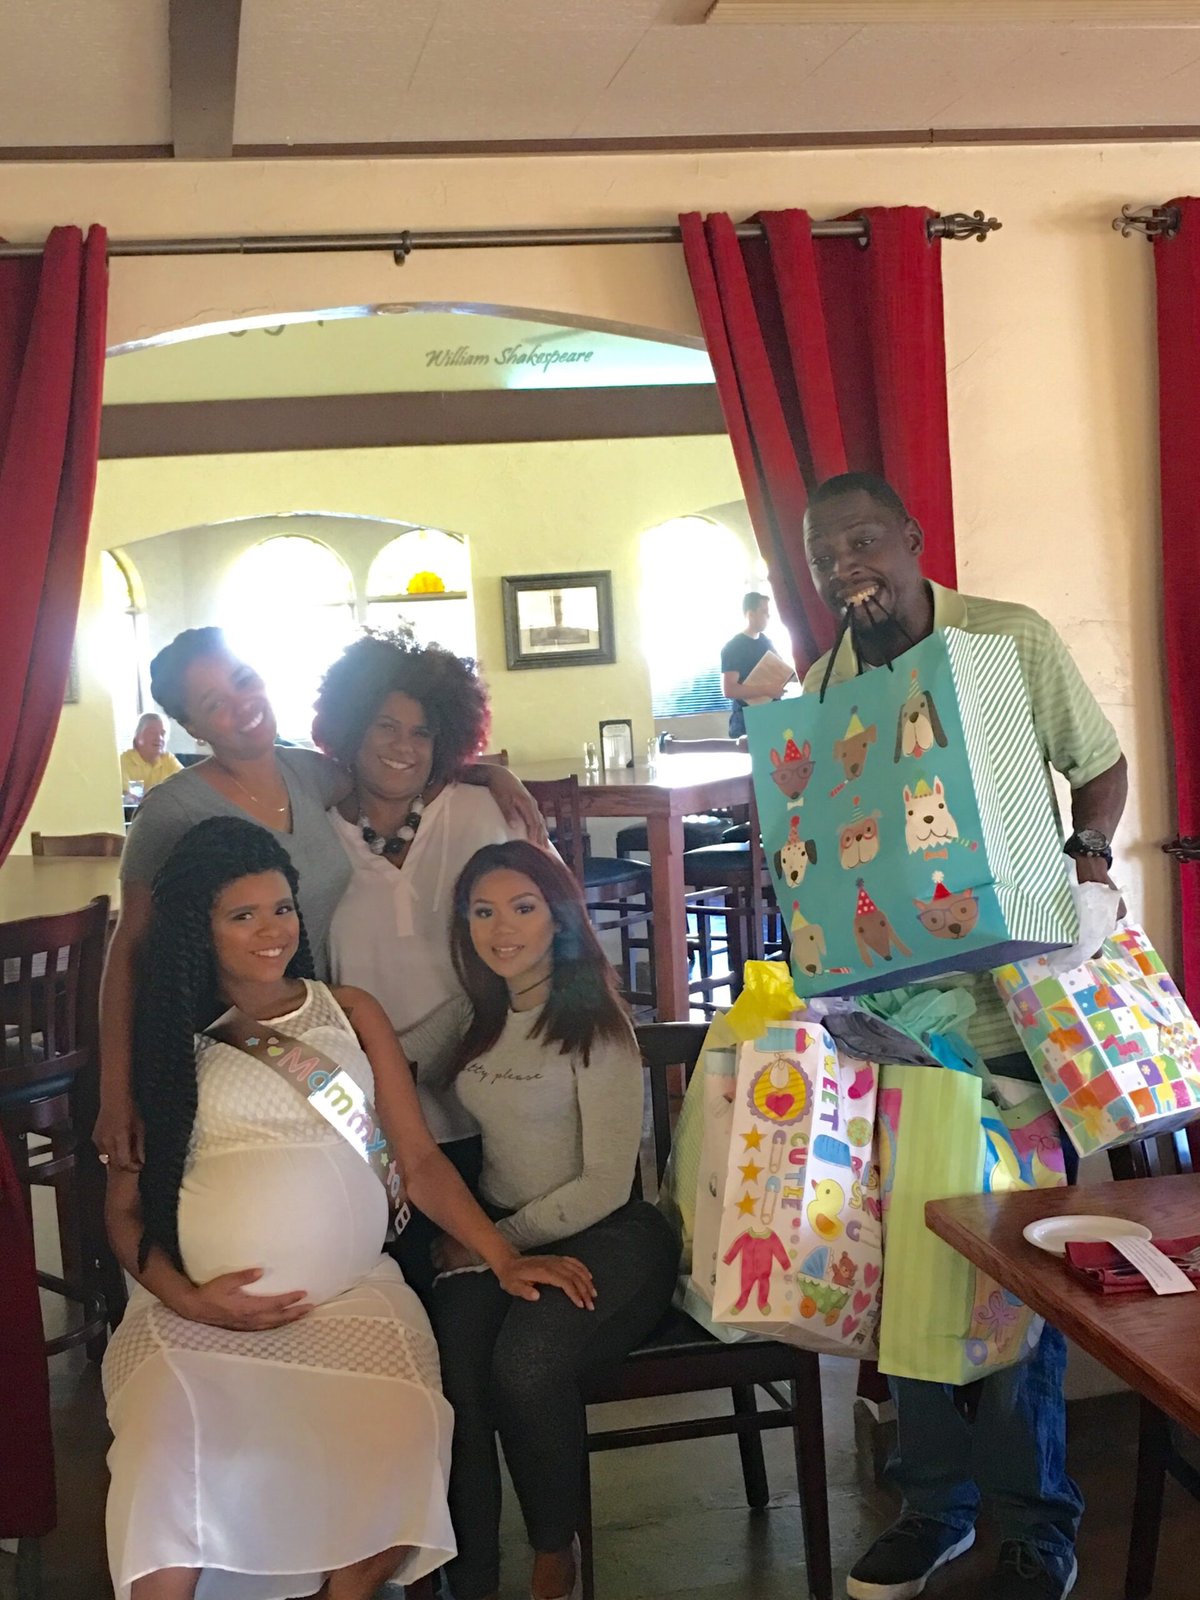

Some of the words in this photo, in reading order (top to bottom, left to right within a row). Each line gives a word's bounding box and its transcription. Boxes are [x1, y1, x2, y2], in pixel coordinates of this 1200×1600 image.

[425, 345, 490, 368] William
[494, 345, 593, 373] Shakespeare
[277, 1048, 387, 1153] Mommy
[491, 1069, 544, 1085] please
[819, 1031, 840, 1132] SWEET
[780, 1132, 809, 1212] CUTIE
